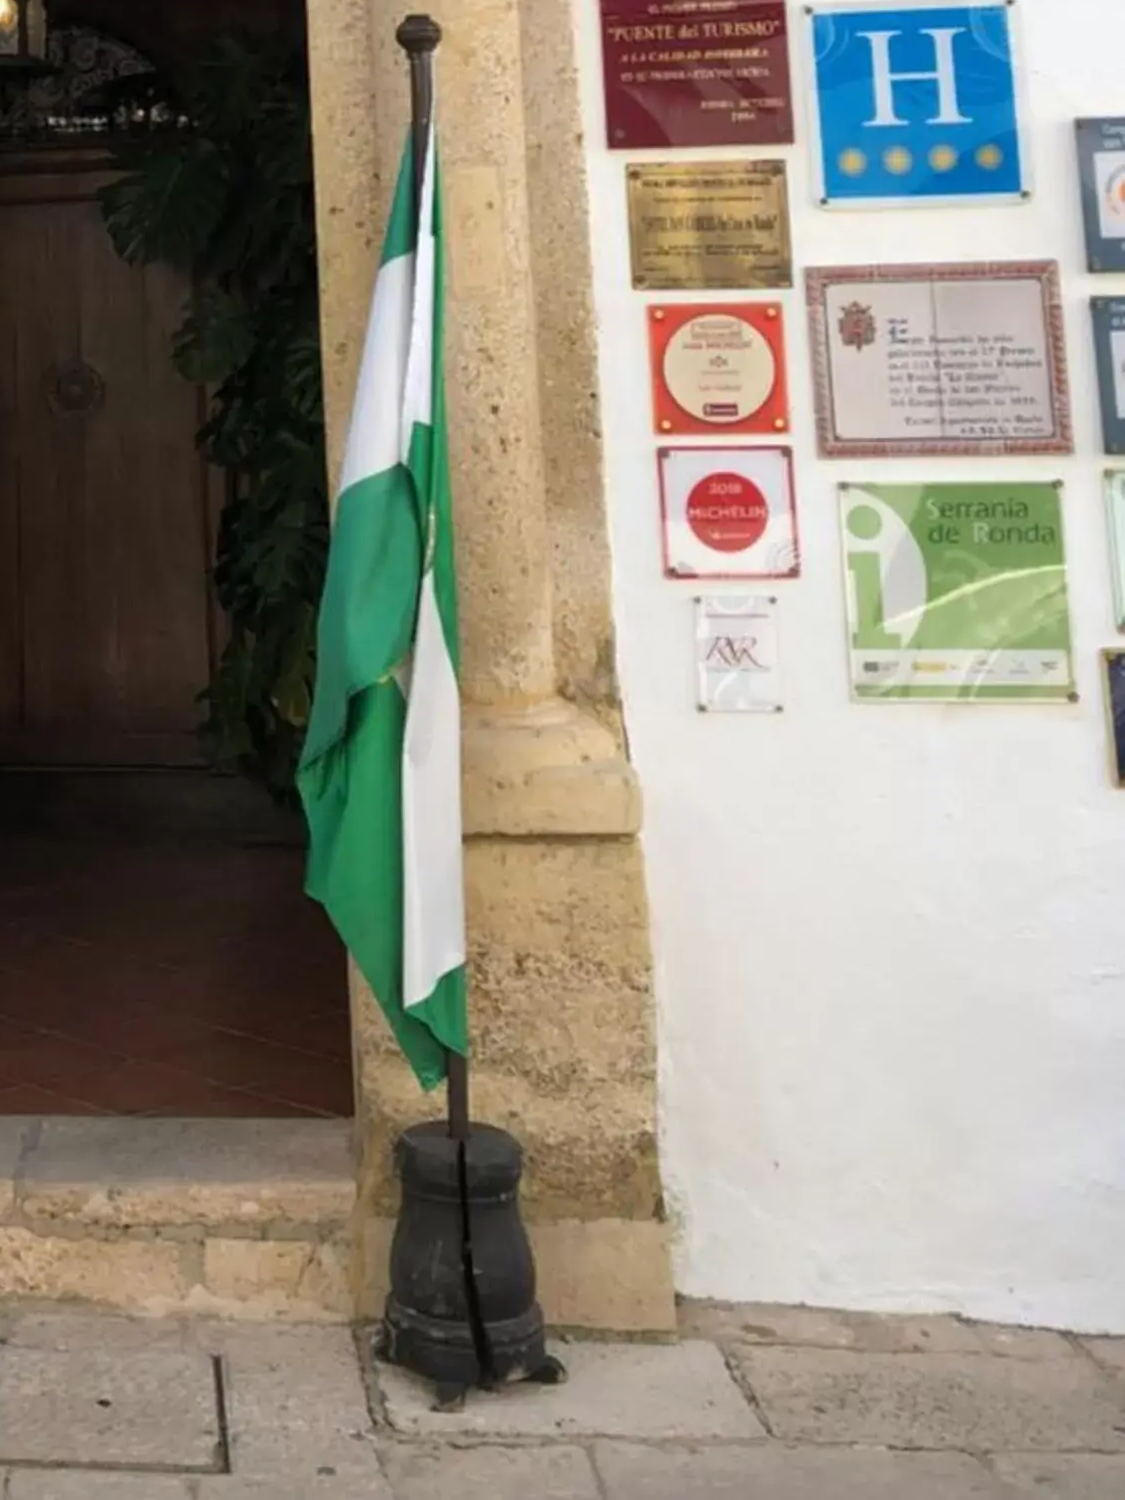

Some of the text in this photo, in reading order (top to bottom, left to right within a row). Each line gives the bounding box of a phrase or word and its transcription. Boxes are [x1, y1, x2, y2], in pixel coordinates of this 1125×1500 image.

[678, 23, 698, 38] del
[855, 27, 973, 127] H
[928, 522, 1056, 545] de Ronda
